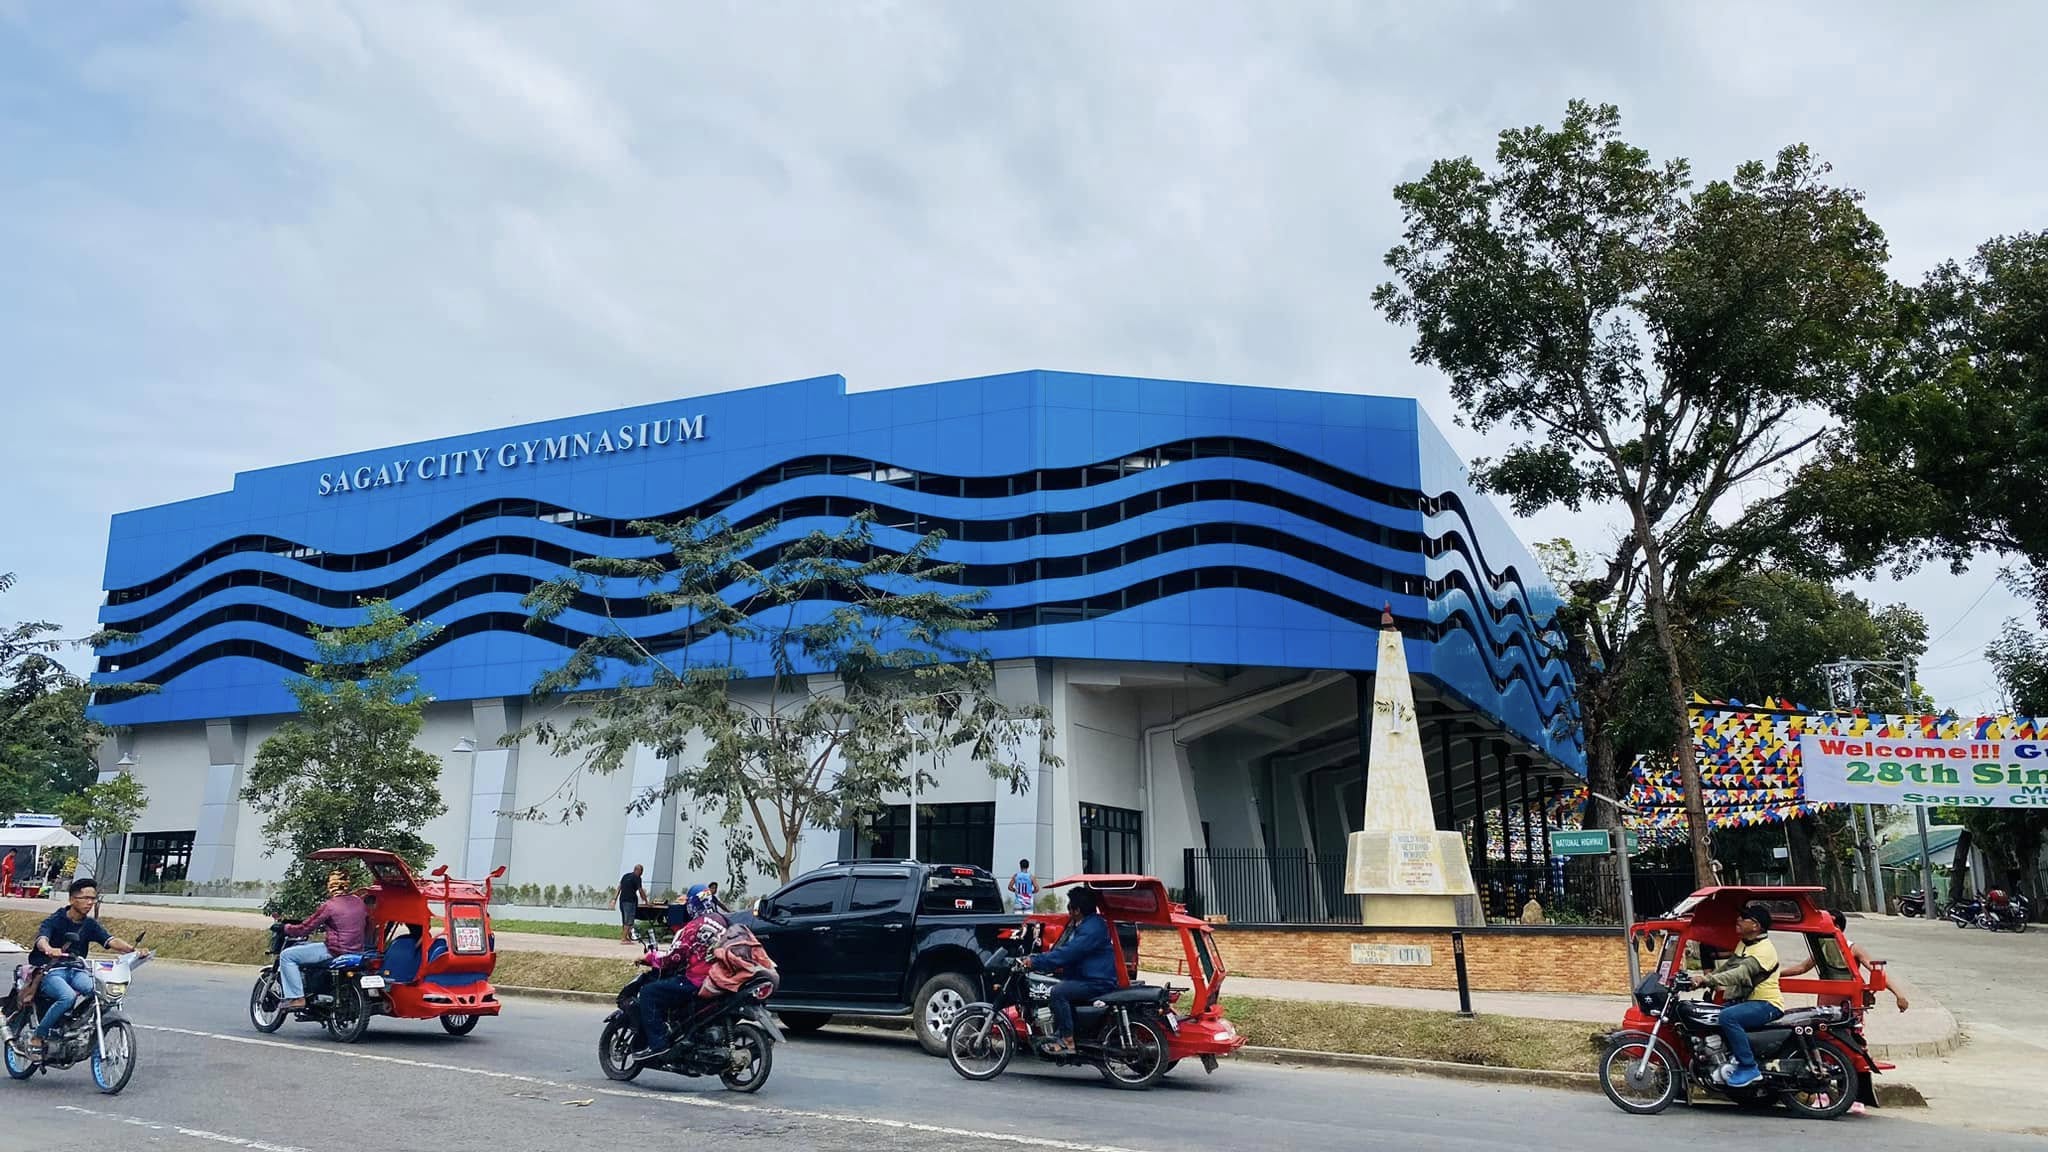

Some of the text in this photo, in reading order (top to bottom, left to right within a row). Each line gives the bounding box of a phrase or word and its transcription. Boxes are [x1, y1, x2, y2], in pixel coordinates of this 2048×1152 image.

[318, 414, 706, 496] SAGAY CITY GYMNASIUM
[1819, 739, 2048, 760] Welcome!!! G
[1846, 761, 1960, 785] 28th
[2022, 786, 2048, 795] M
[1903, 793, 1995, 806] Sagay
[1399, 948, 1424, 962] CITY
